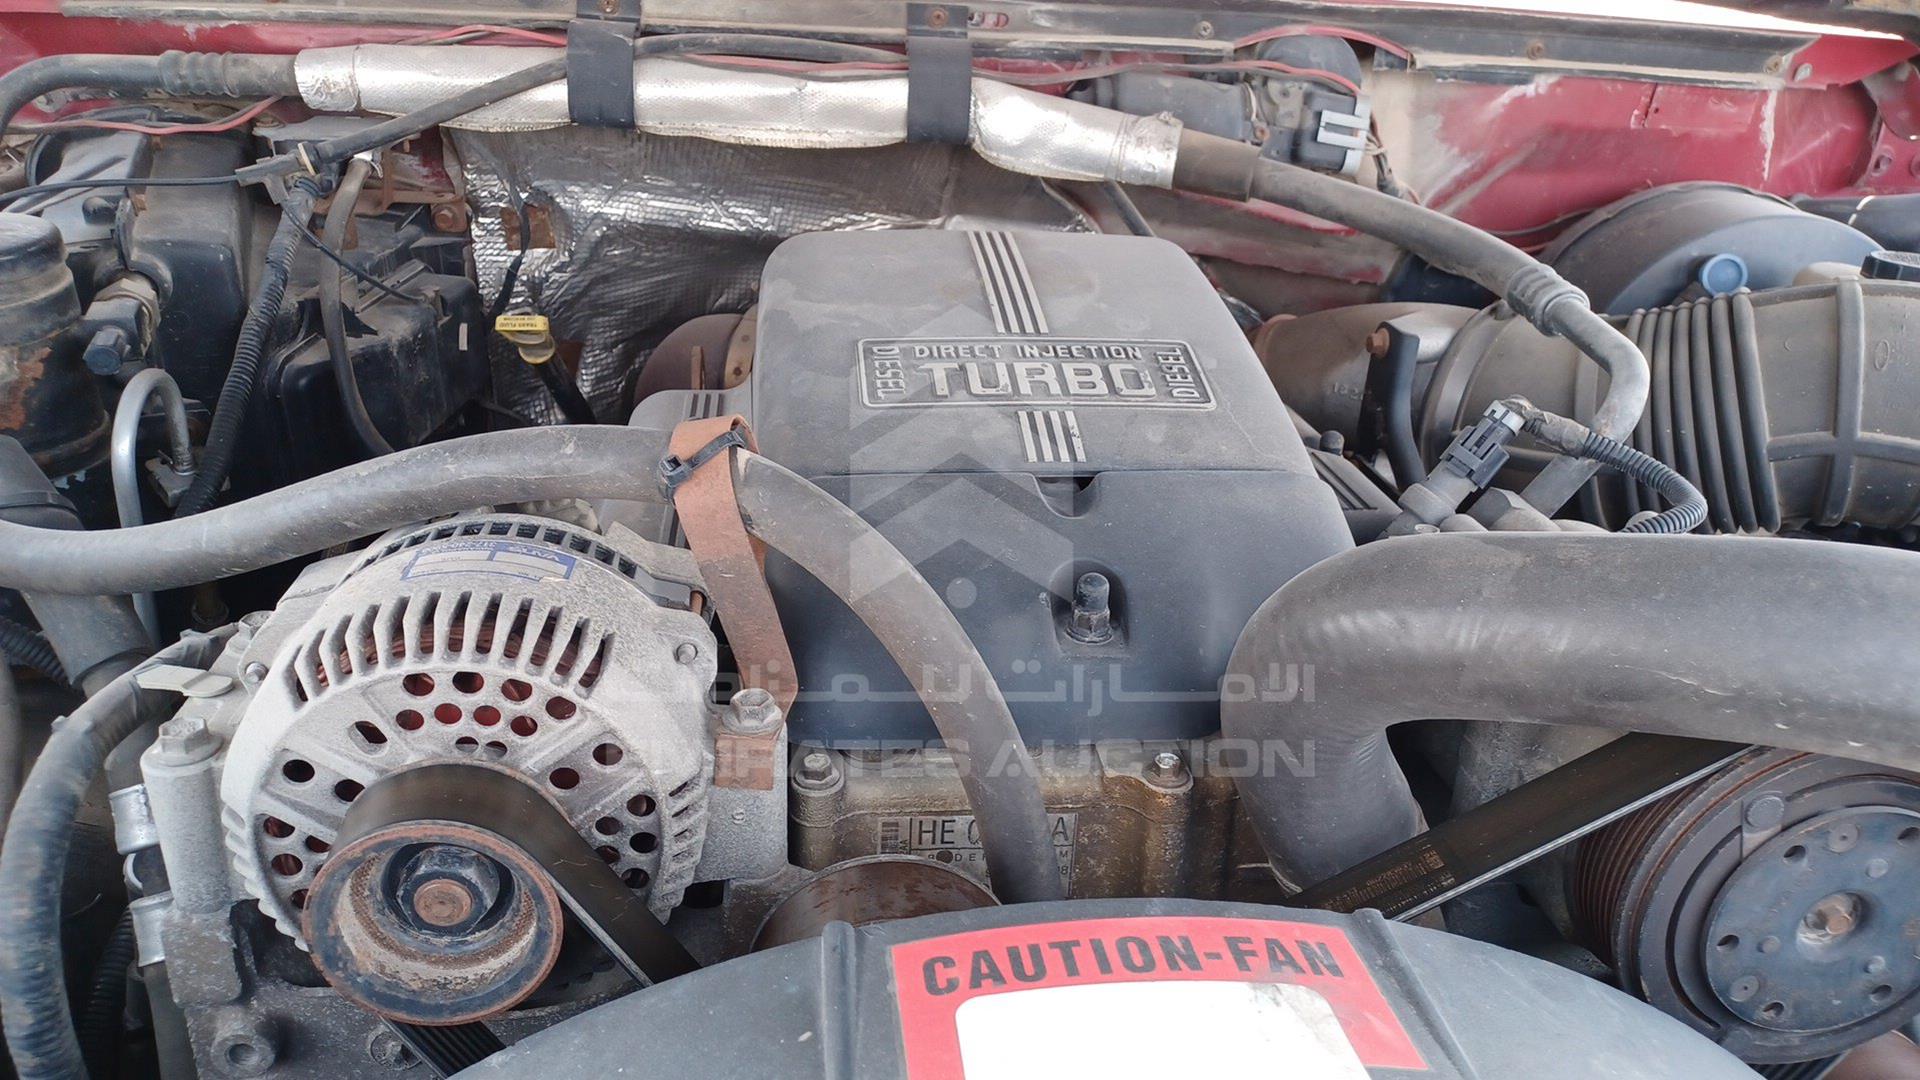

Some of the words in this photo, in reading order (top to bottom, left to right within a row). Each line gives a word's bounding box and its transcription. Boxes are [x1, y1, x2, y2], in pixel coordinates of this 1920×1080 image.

[872, 345, 906, 399] DIESEL
[913, 344, 1001, 359] DIRECT
[1017, 344, 1143, 360] INJECTION
[1156, 347, 1202, 400] DIESEL
[916, 361, 1157, 398] TURBO
[921, 934, 1345, 997] CAUTION-FAN
